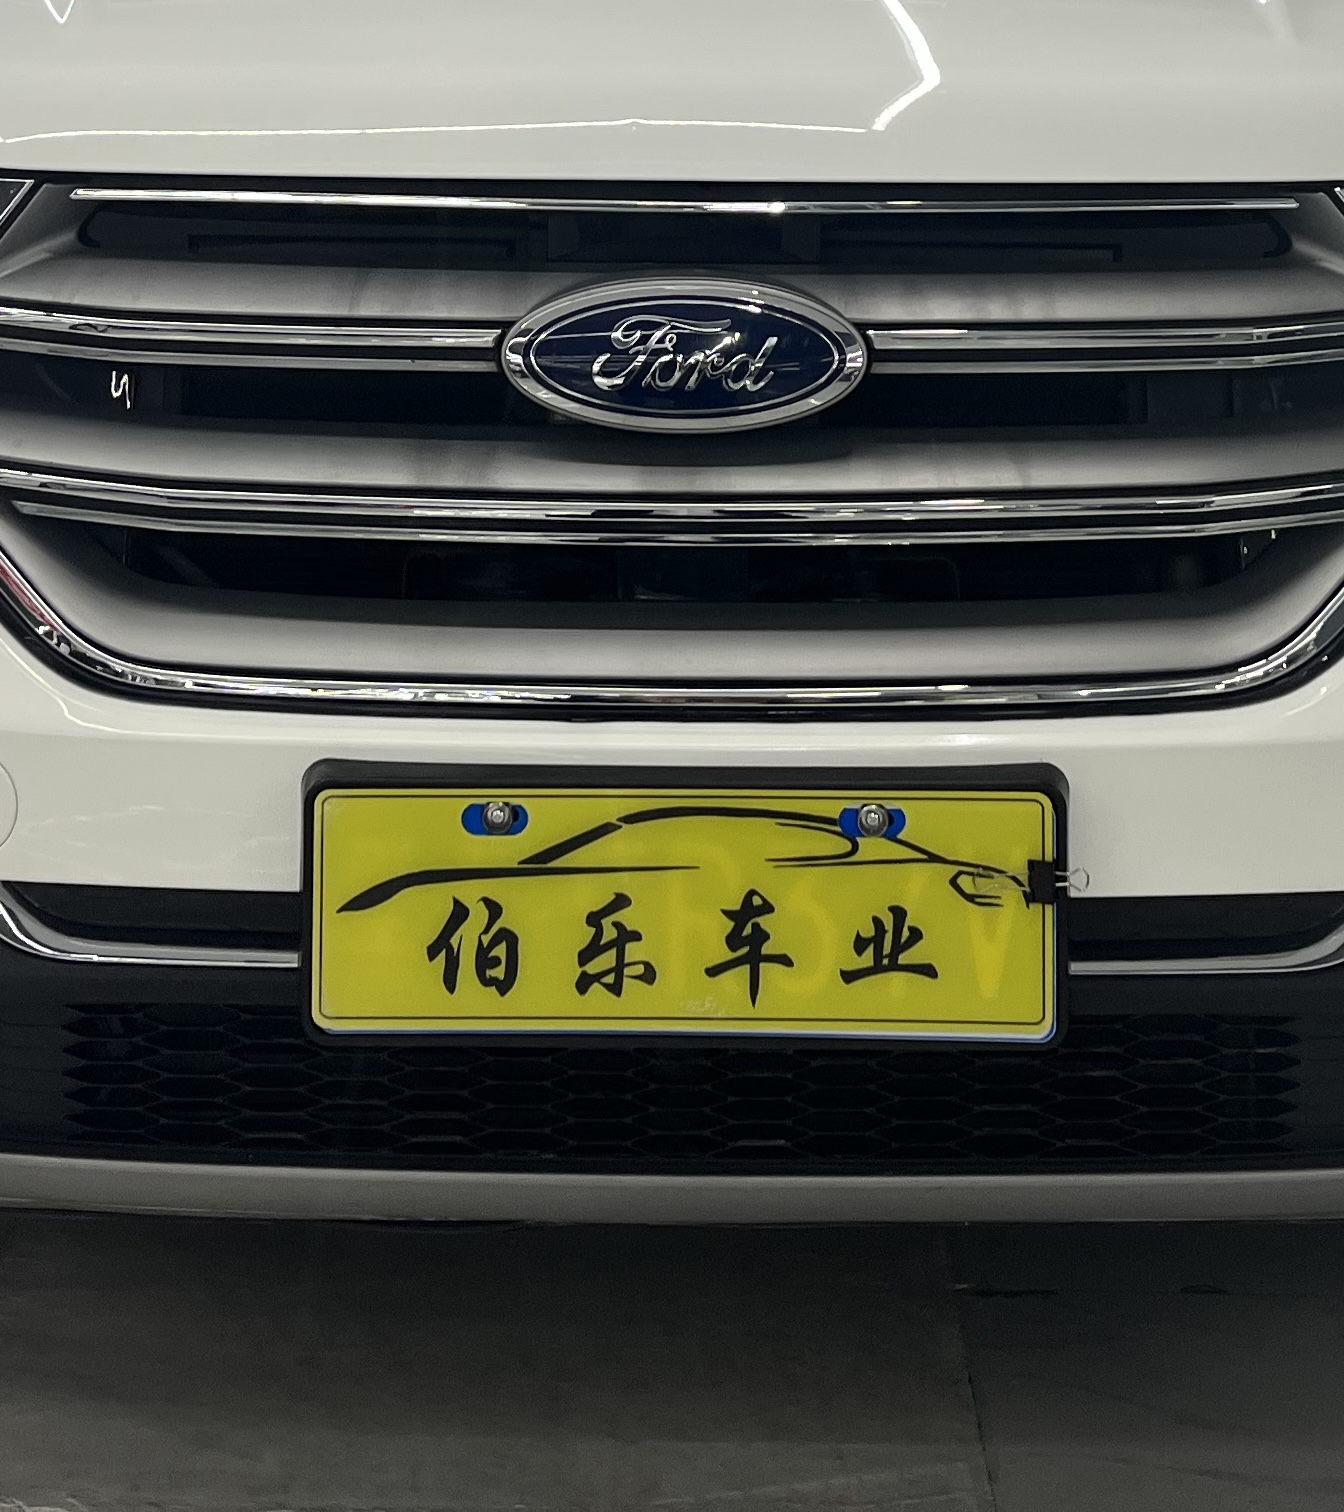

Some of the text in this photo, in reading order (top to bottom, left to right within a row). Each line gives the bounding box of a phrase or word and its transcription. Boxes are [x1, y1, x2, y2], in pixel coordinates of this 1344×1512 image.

[592, 314, 778, 392] Ford
[426, 887, 939, 1008] 伯乐车业
